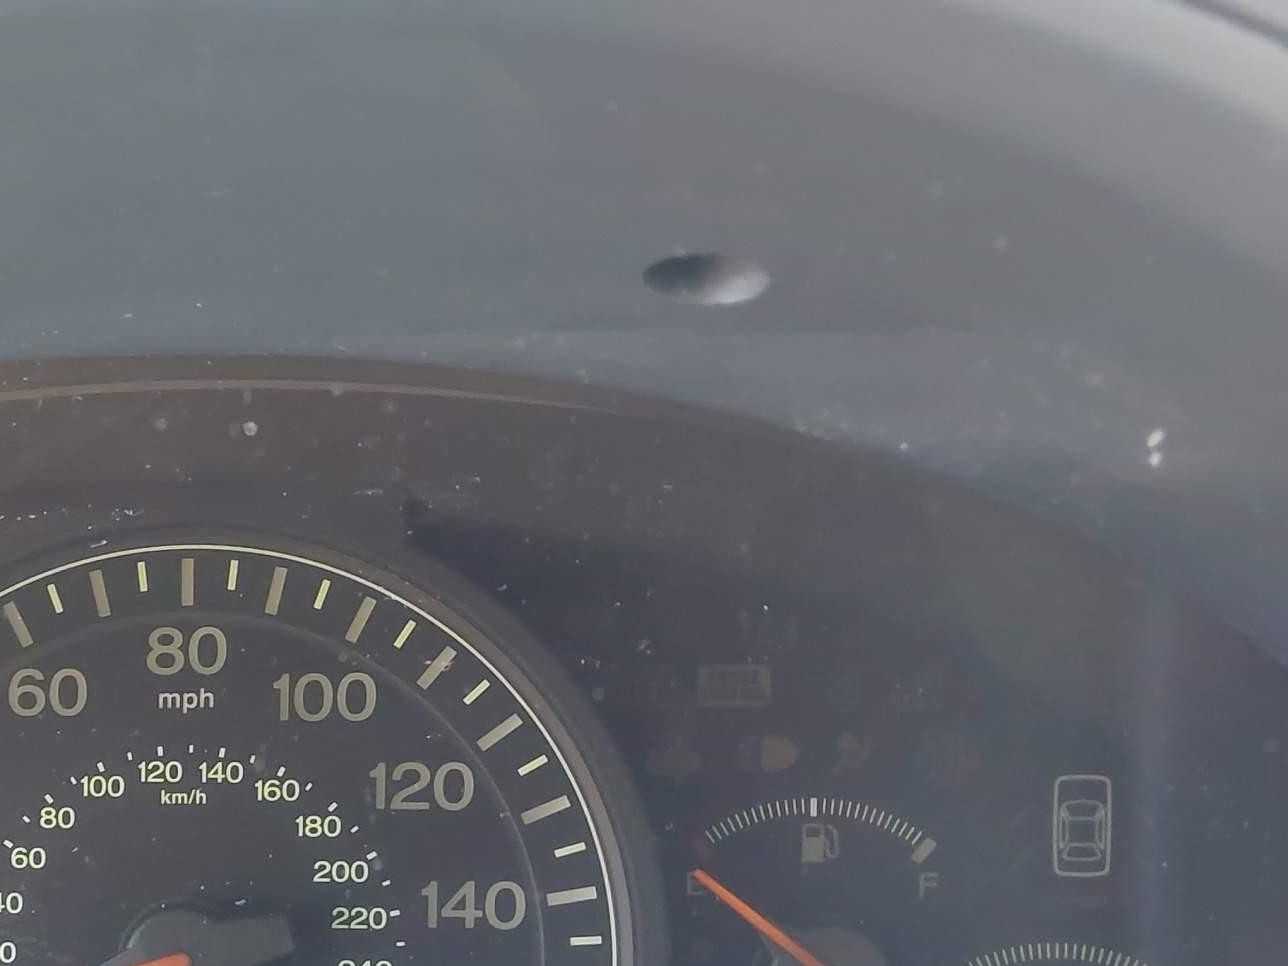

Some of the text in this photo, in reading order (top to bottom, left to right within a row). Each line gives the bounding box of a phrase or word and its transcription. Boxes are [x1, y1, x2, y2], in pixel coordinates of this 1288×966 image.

[146, 627, 227, 675] 80
[8, 668, 88, 717] 60
[158, 688, 215, 714] mph
[272, 672, 378, 722] 100
[138, 760, 183, 784] 120
[198, 760, 244, 784] 140
[80, 775, 125, 799] 100
[160, 788, 207, 806] km/h
[254, 779, 300, 802] 160
[368, 761, 475, 811] 120
[39, 806, 76, 829] 80
[295, 815, 343, 838] 180
[10, 847, 47, 870] 60
[312, 861, 369, 884] 200
[920, 872, 941, 897] F
[421, 880, 527, 930] 140
[331, 907, 388, 930] 220
